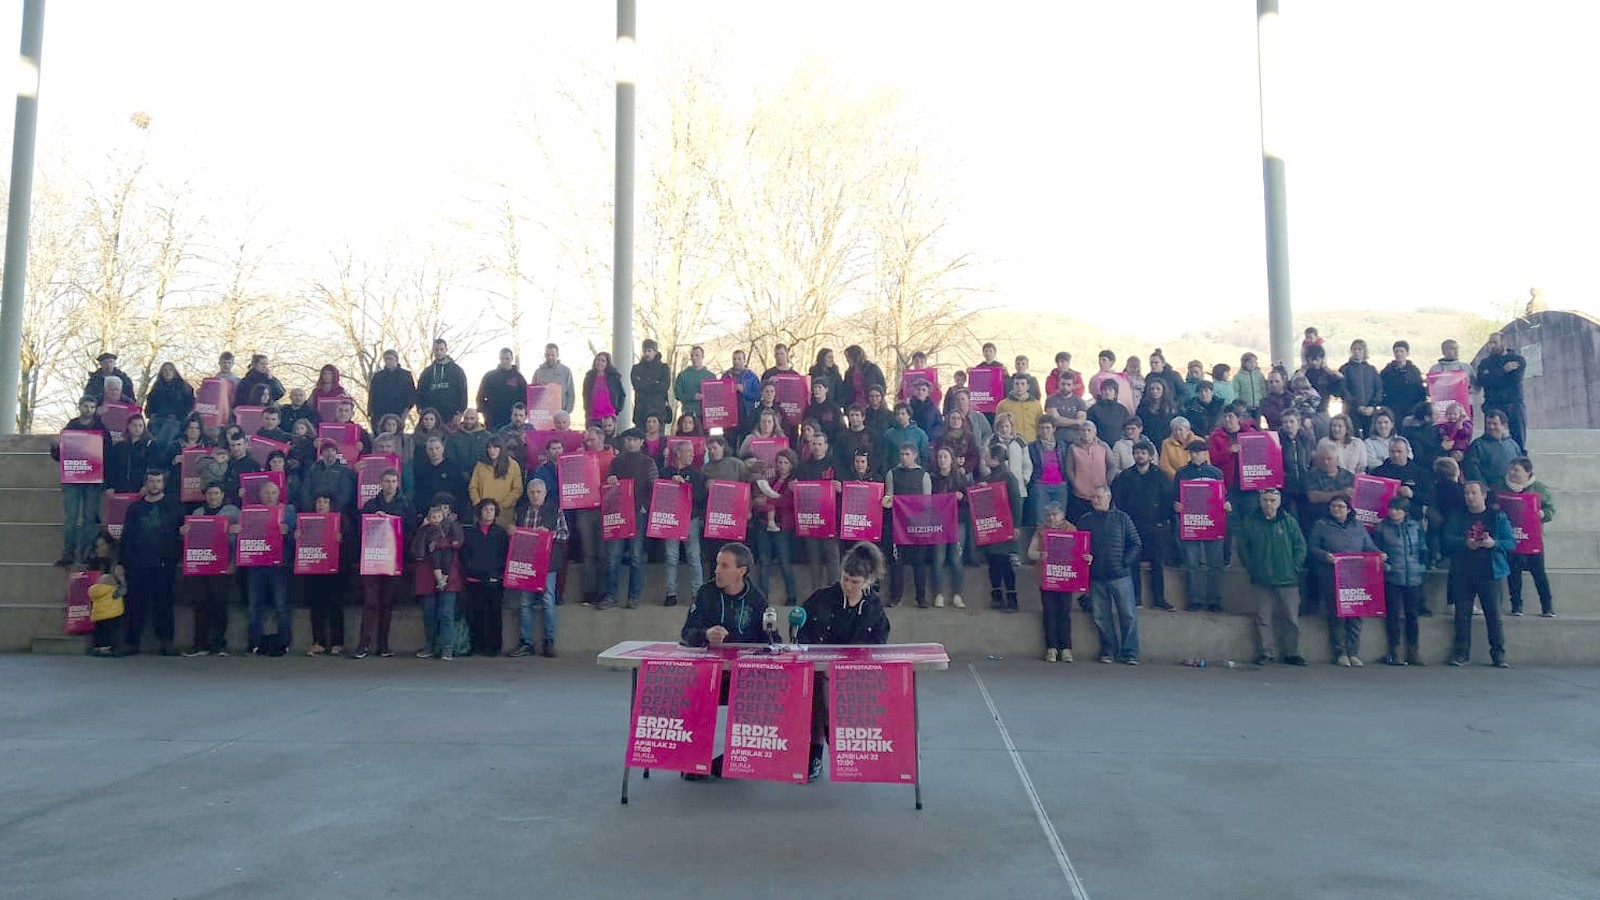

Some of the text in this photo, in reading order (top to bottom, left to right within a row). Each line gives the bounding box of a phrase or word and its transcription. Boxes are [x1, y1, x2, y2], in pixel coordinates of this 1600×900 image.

[907, 524, 943, 534] BIZIRIK
[642, 686, 684, 696] AREN
[735, 691, 776, 702] AREN
[836, 693, 876, 704] AREN
[637, 716, 684, 730] ERDIZ
[635, 727, 693, 743] BIZIRIK
[732, 724, 779, 738] ERDIZ
[836, 727, 883, 740] ERDIZ
[634, 740, 676, 750] APIRILAK 22
[731, 736, 789, 750] BIZIRIK
[836, 740, 894, 752] BIZIRIK
[731, 749, 763, 757] APIRILAK
